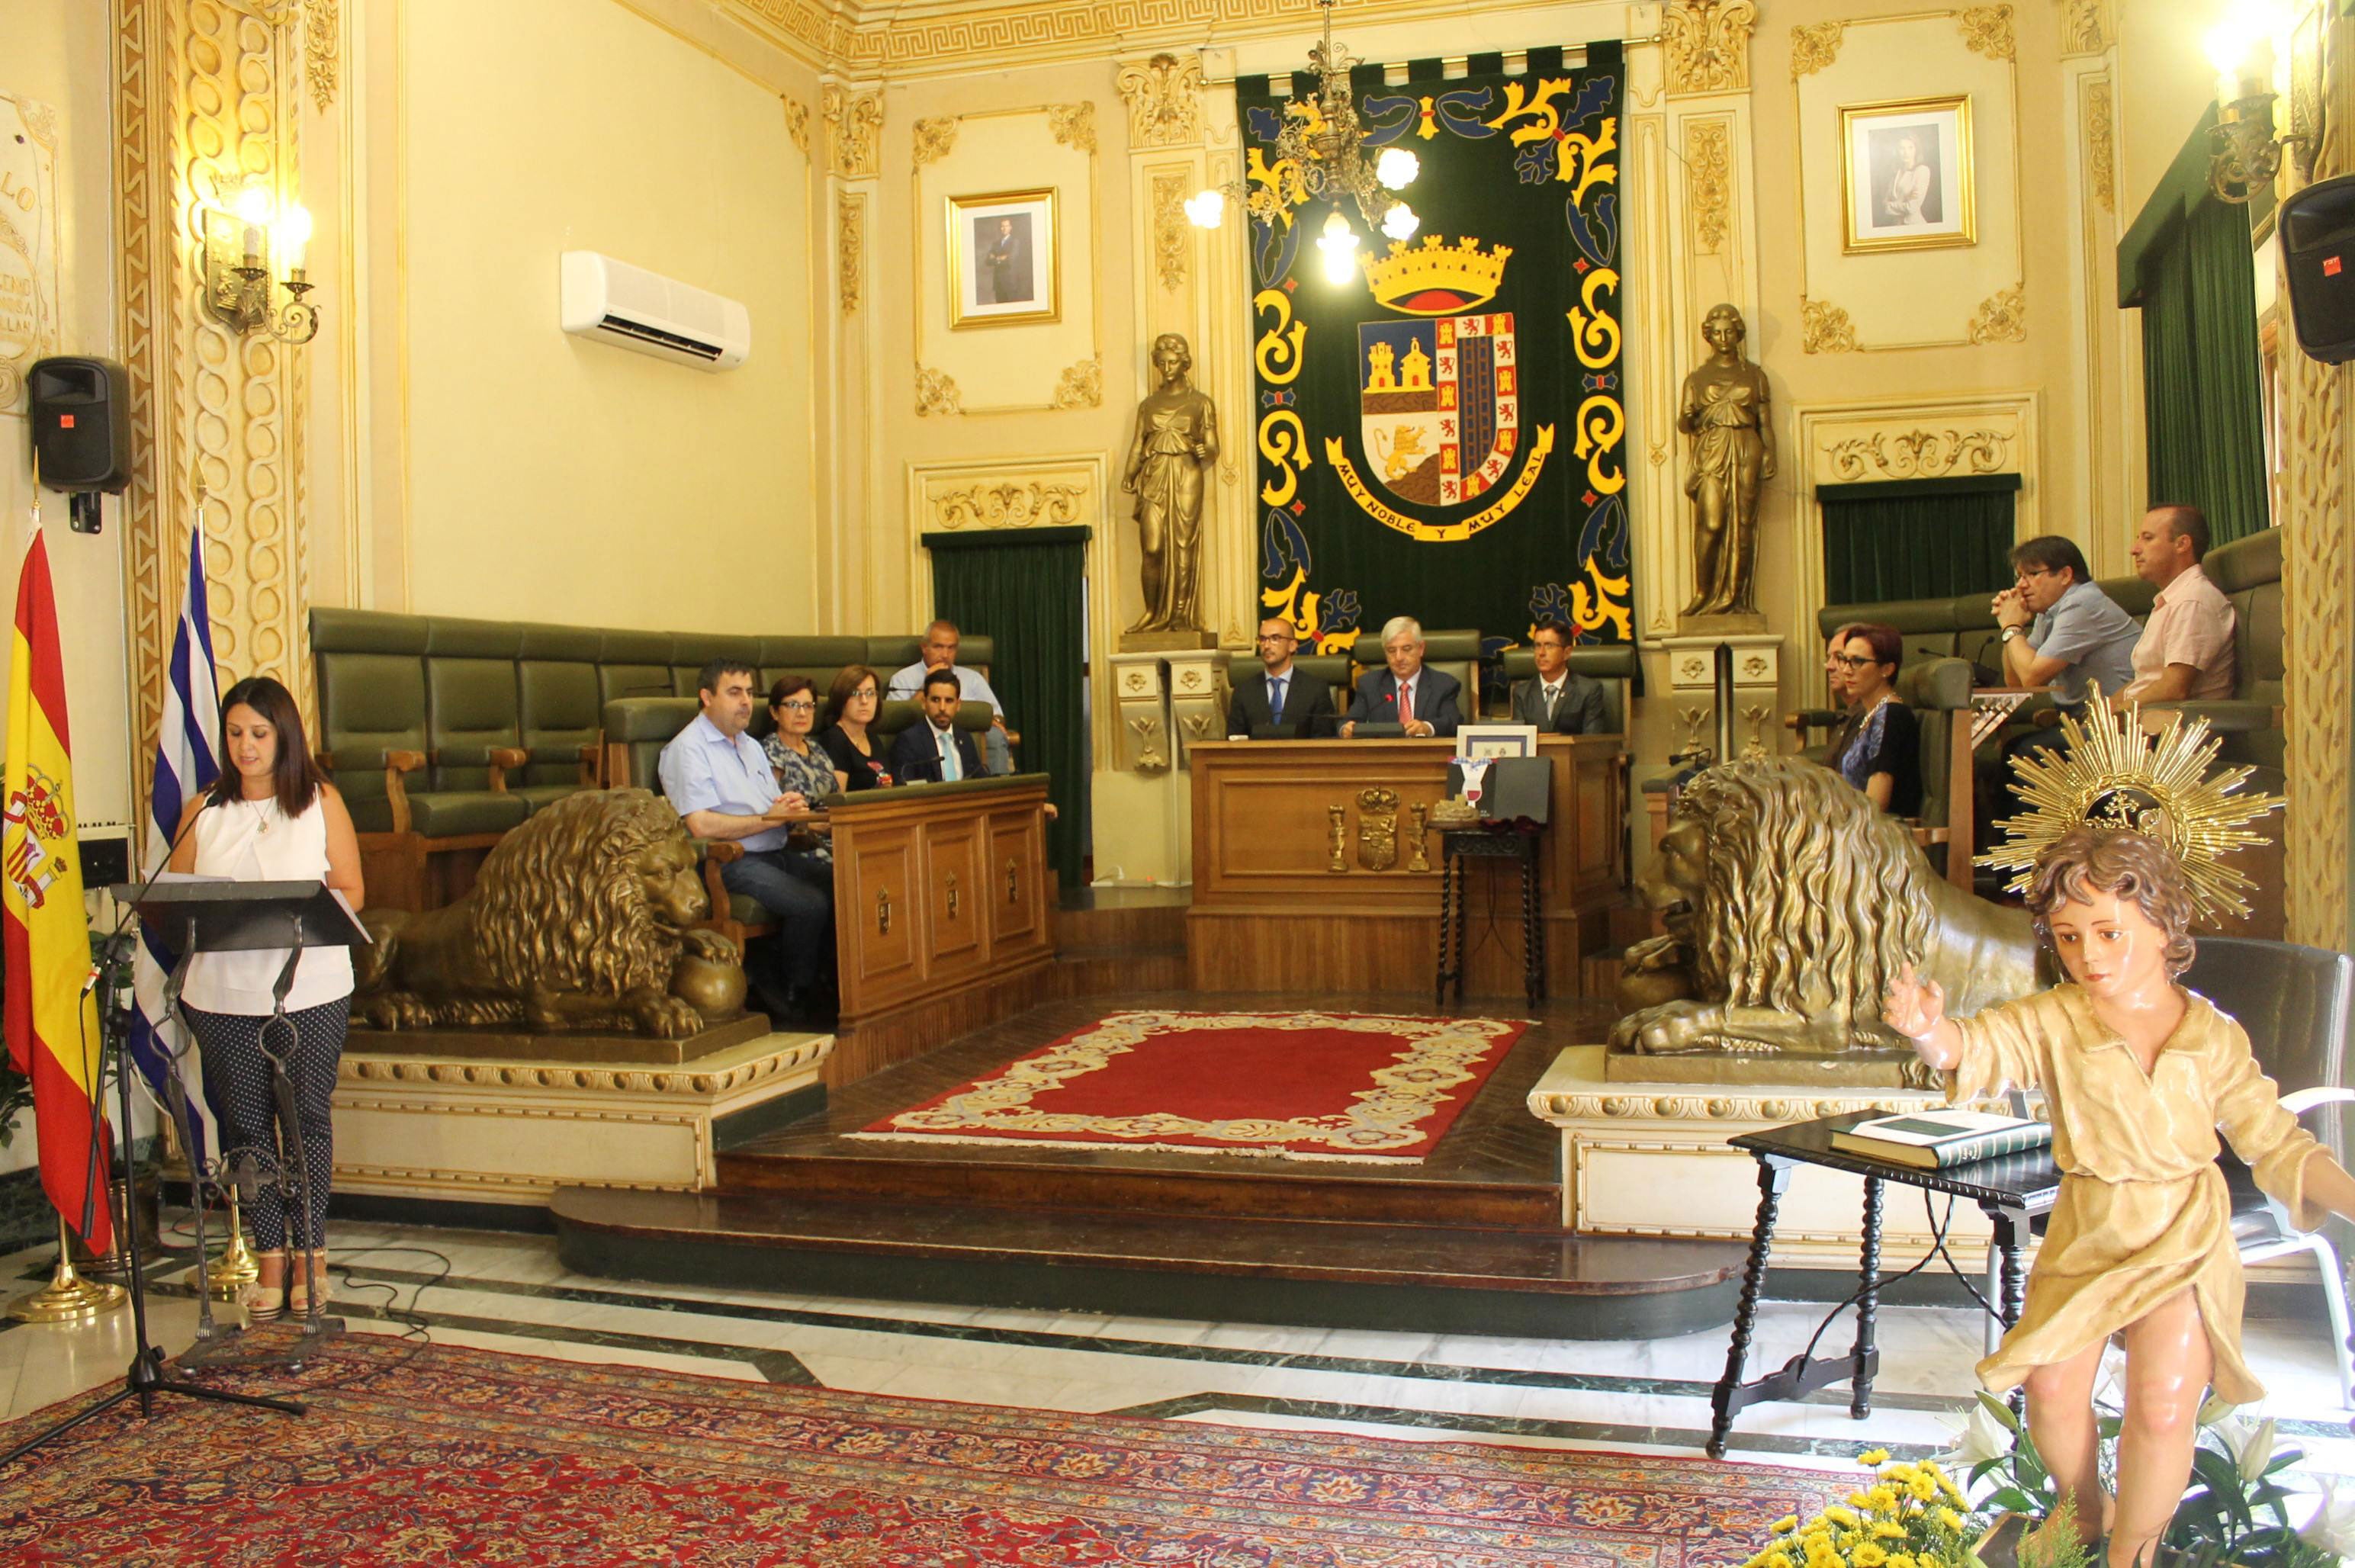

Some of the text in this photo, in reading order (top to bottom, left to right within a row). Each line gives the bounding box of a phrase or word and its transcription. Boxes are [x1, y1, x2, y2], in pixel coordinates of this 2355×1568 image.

[1338, 452, 1544, 539] MUY NOBLE Y MUY LEAL
